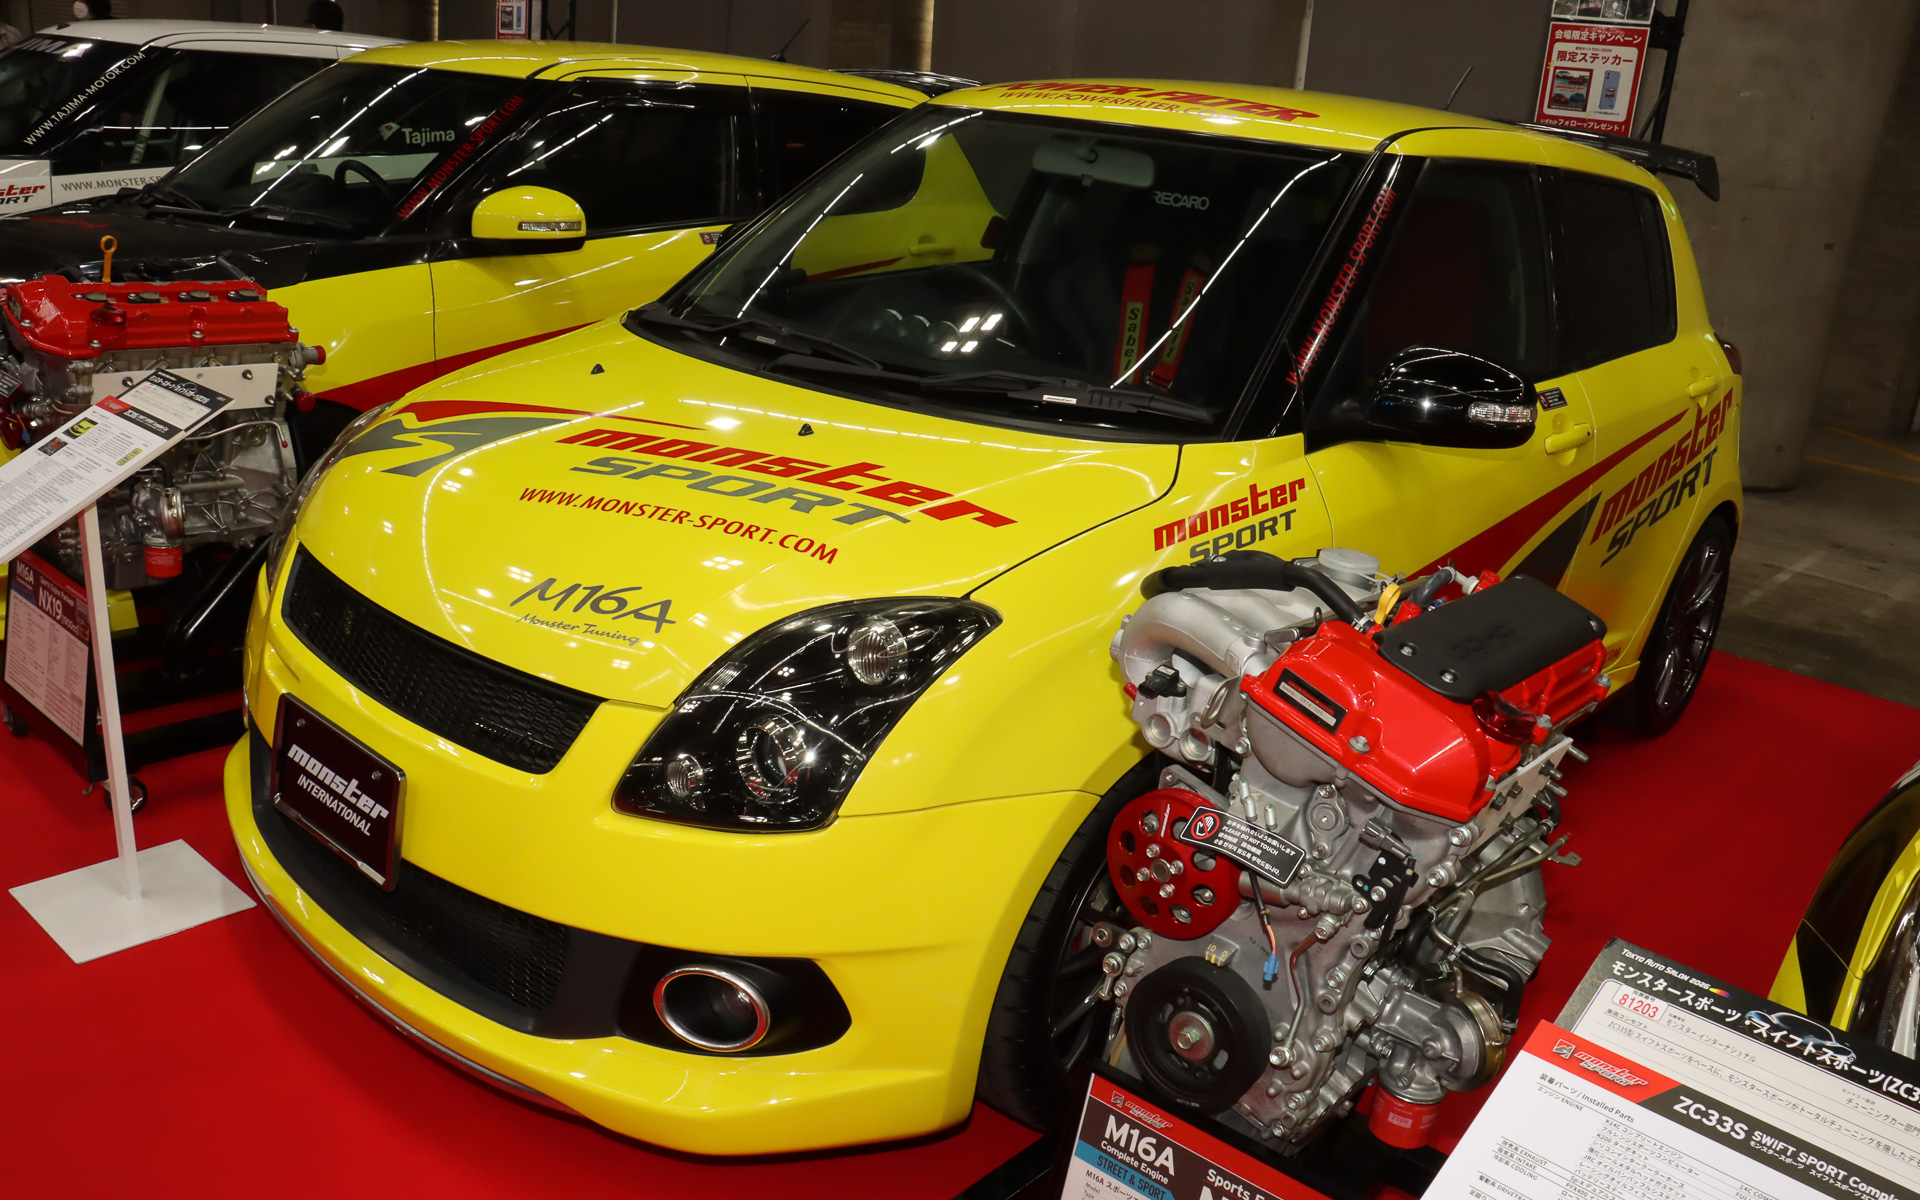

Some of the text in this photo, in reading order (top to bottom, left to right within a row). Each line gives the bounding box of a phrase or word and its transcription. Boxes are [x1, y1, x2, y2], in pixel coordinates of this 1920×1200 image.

[1555, 29, 1642, 44] 会場限定キャンペーン
[1557, 50, 1634, 66] 限定ステッカー
[23, 51, 146, 145] WWW.TAJIMA-MOTOR.COM
[979, 82, 1321, 123] POWER FILTER
[999, 91, 1238, 121] WWW.POWERFILTER.COM
[397, 95, 525, 219] WWW.MONSTER-SPORT.COM
[401, 128, 455, 147] Tajima
[60, 175, 164, 192] WWW.MONSTER-SP
[1154, 190, 1210, 211] RECARO
[1286, 184, 1398, 387] WWW.MONSTER-SPORT.COM
[1124, 307, 1141, 372] Sabel
[554, 428, 1019, 528] monster
[1589, 386, 1734, 546] monster
[568, 456, 912, 526] SPORT
[1600, 445, 1718, 569] SPORT
[518, 487, 839, 564] WWW.MONSTER-SPORT.COM
[1153, 477, 1306, 552] monster
[1190, 508, 1297, 567] SPORT
[39, 586, 63, 620] NX19
[509, 577, 677, 634] M16A
[516, 613, 641, 647] Monster Tuning
[287, 743, 389, 819] monster
[297, 773, 371, 836] INTERNATIONAL
[1222, 825, 1279, 856] PLEASE DO NOT TOUCH
[1618, 993, 1659, 1019] 81203
[1688, 977, 1711, 991] 2026
[1611, 960, 1920, 1105] モンスタースポーツ・スイフトスポーツ(ZC3
[1666, 1018, 1757, 1063] モンスター インターナショナル
[1574, 1051, 1649, 1086] monster
[1579, 1060, 1632, 1087] SPORT
[1124, 1100, 1173, 1128] monster
[1537, 1086, 1584, 1112] エンジン ENGINE
[1540, 1073, 1578, 1094] 装着パーツ
[1582, 1093, 1615, 1114] Installed
[1614, 1109, 1635, 1124] Parts
[1104, 1114, 1175, 1177] M16A
[1519, 1149, 1548, 1167] EXHAUST
[1672, 1095, 1750, 1141] ZC33S
[1752, 1130, 1797, 1157] SWIFT
[1796, 1151, 1848, 1181] SPORT
[1085, 1169, 1104, 1186] M16A
[1097, 1155, 1166, 1200] STREET & SPORT
[1101, 1140, 1169, 1185] Complete Engine
[1206, 1168, 1251, 1200] Sports
[1510, 1163, 1539, 1181] COOLING
[1515, 1156, 1538, 1171] INTAKE
[1750, 1140, 1805, 1170] モンスタースポーツ
[1809, 1168, 1861, 1199] スイフトスポーツ
